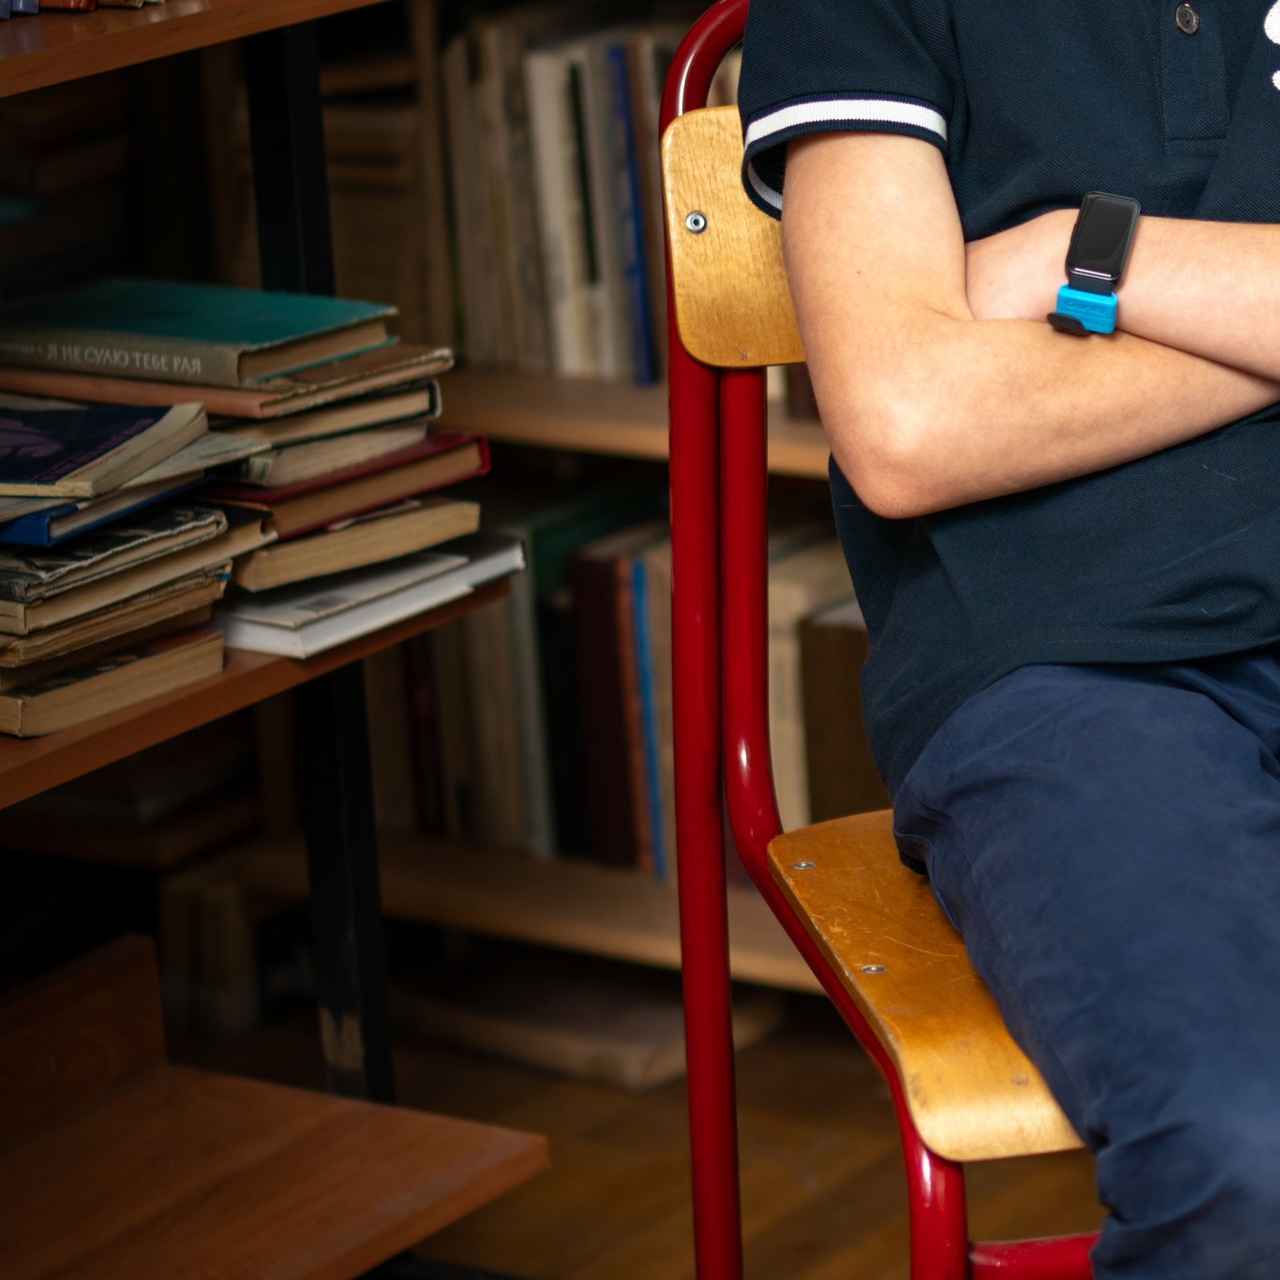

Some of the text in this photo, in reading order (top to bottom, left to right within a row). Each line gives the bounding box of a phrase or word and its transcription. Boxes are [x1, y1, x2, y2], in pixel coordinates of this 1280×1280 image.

[46, 343, 58, 361] Я
[61, 344, 82, 363] НЕ
[84, 347, 130, 369] СУЛЮ
[131, 352, 168, 372] ТЕБЕ
[173, 356, 202, 375] РАЯ
